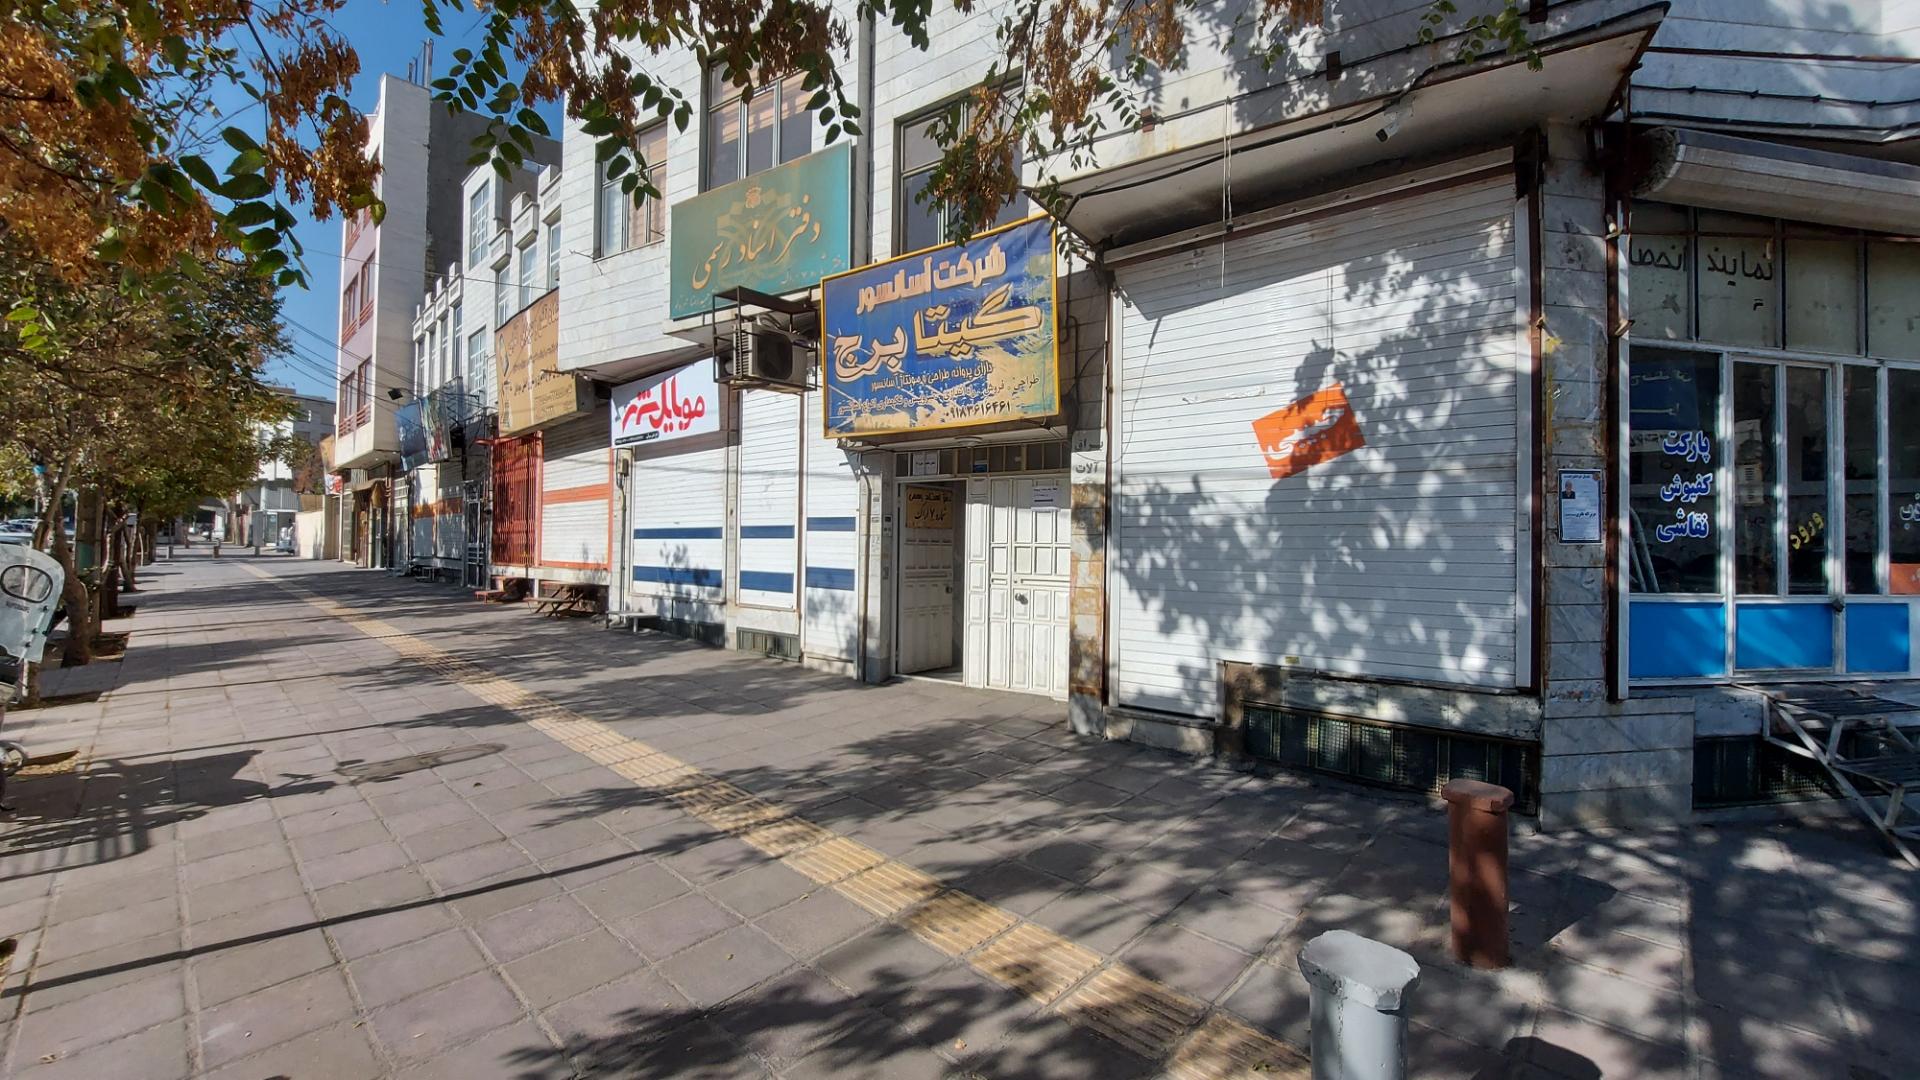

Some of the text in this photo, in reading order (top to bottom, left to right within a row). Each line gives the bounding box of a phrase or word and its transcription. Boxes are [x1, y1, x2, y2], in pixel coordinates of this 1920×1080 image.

[737, 219, 778, 266] اسناد
[773, 193, 822, 265] دفتر
[691, 240, 733, 291] رسمی
[856, 255, 933, 315] آسانسور
[934, 243, 1007, 290] شرکت
[833, 283, 1044, 381] گیتا برج
[950, 365, 973, 380] پروانه
[974, 359, 994, 377] دارای
[1014, 374, 1040, 391] طراحی
[648, 374, 705, 434] موبایل
[1662, 430, 1711, 464] پارکت
[1074, 461, 1099, 475] آلات
[1659, 472, 1714, 504] کفپوش
[1655, 506, 1710, 543] نقاشی
[1789, 511, 1825, 551] ورود
